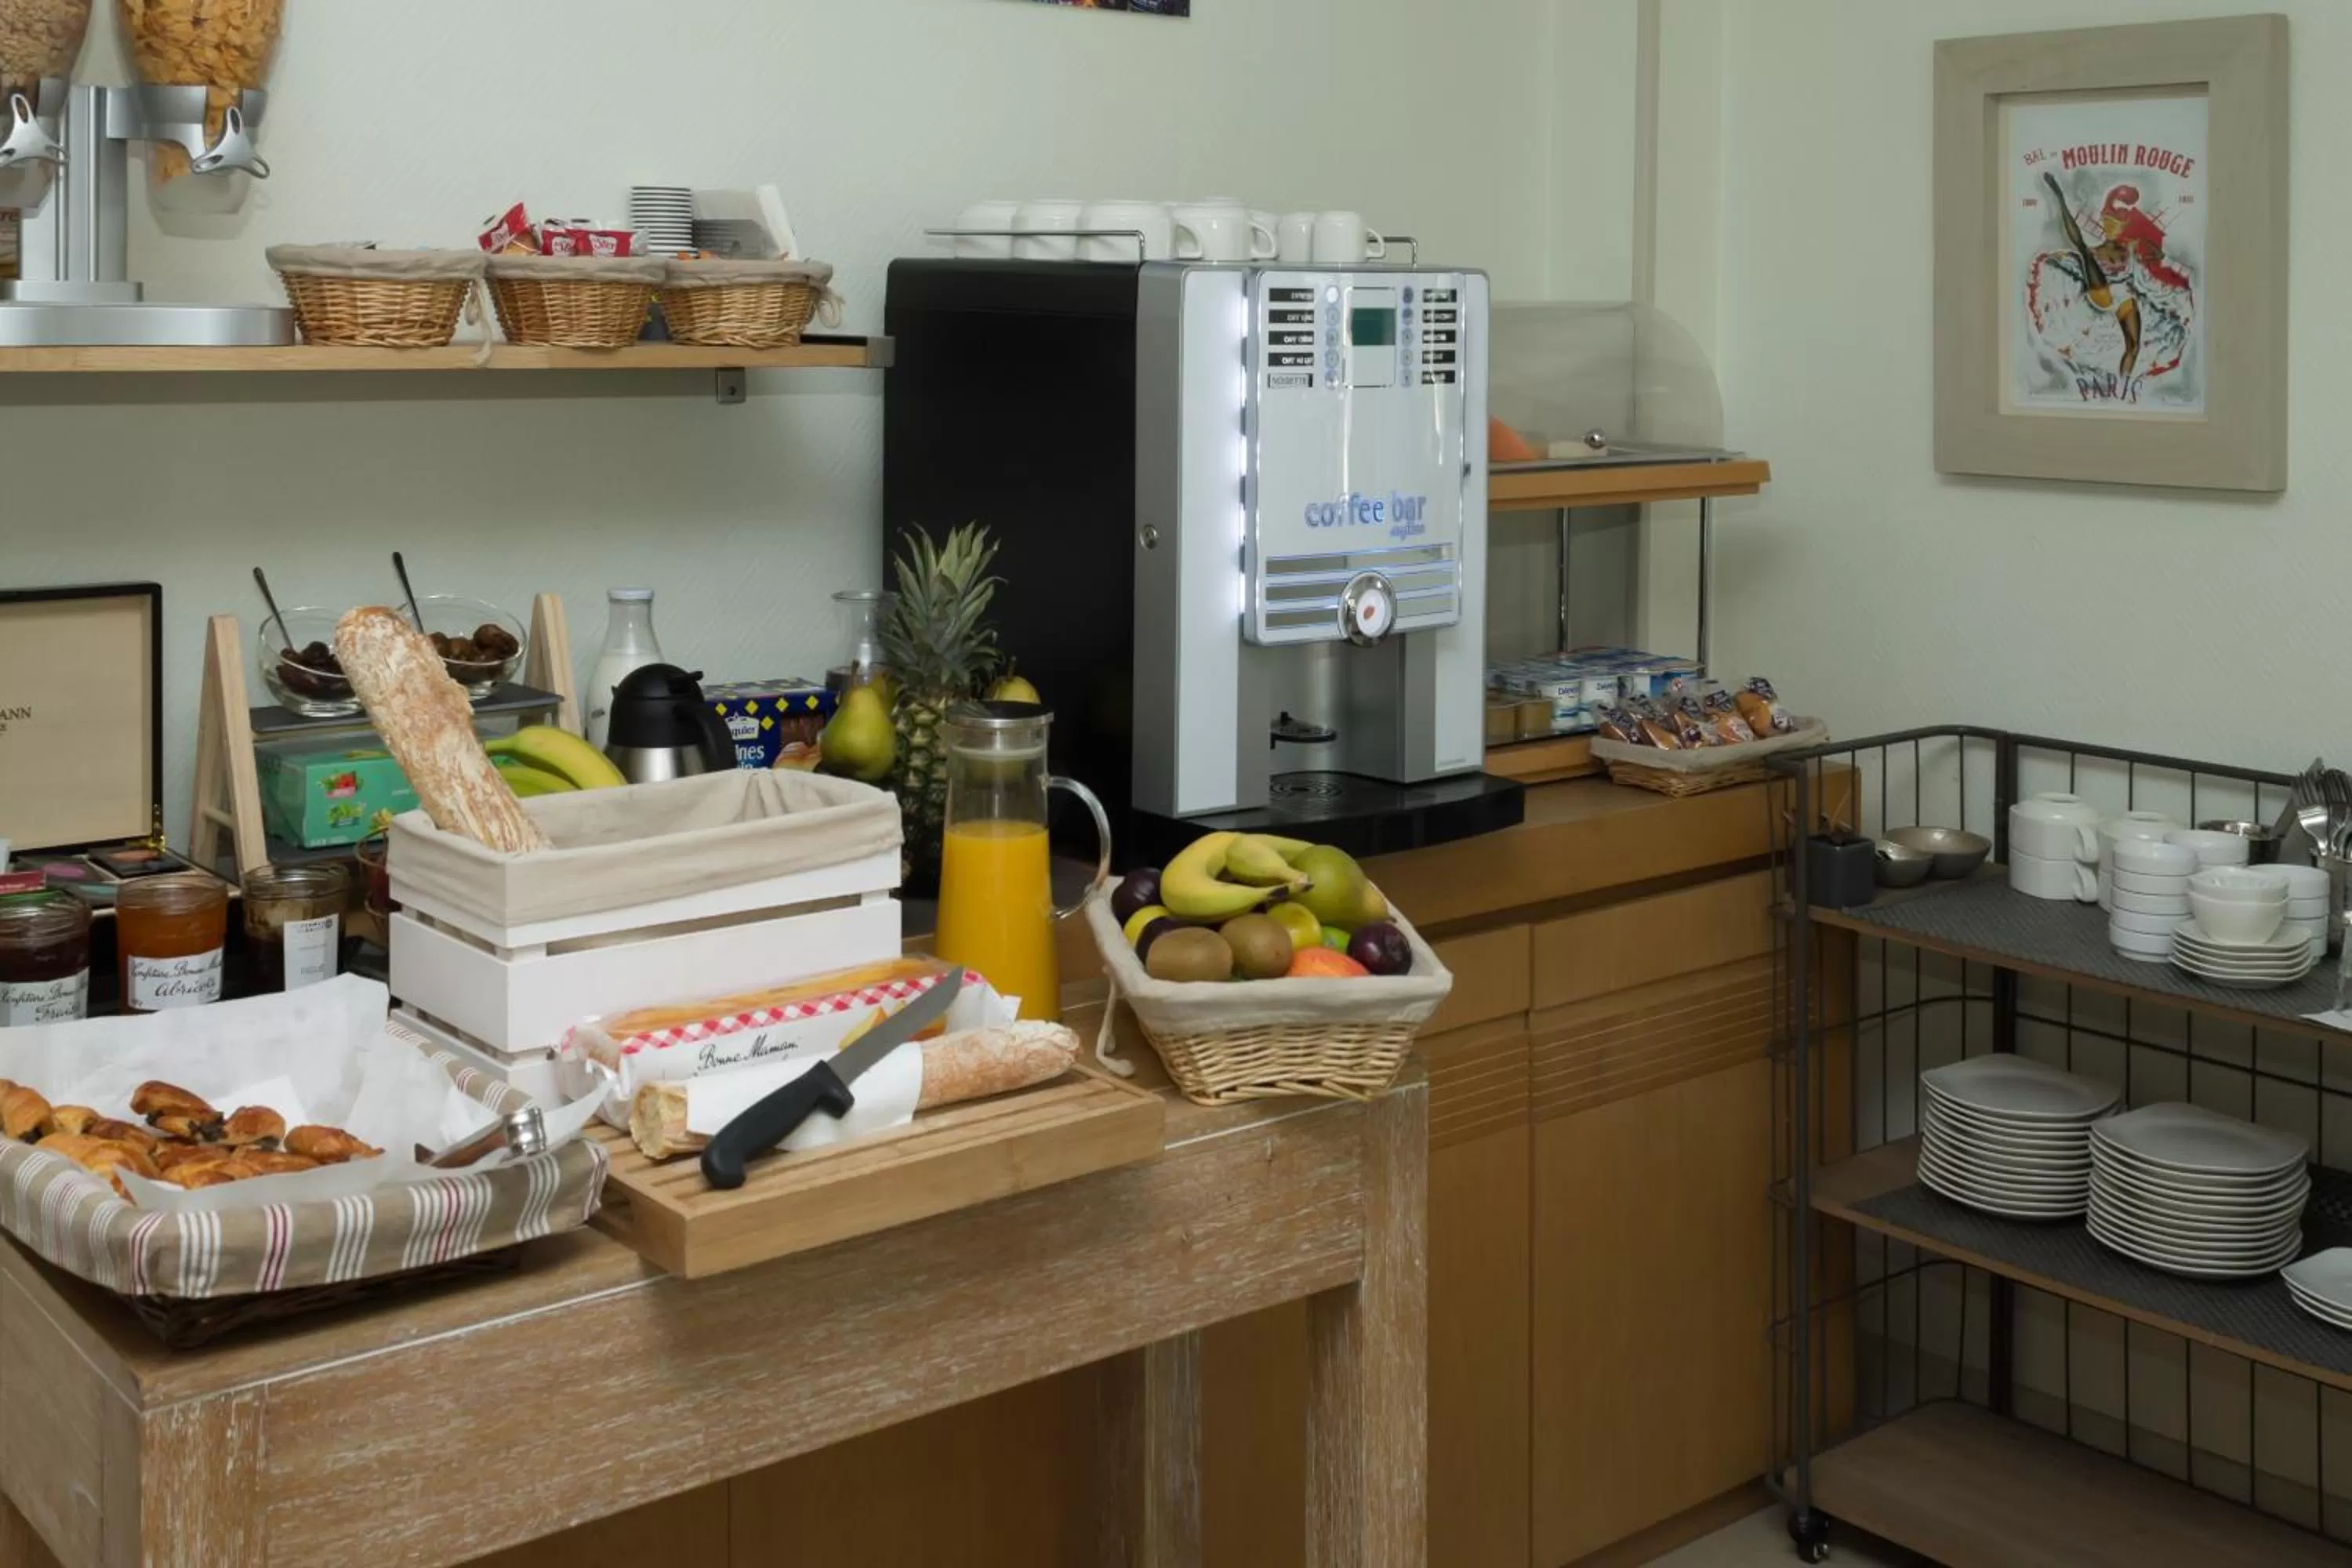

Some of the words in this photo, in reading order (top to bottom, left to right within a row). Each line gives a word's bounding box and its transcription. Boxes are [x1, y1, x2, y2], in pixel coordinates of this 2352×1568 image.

[2062, 143, 2129, 170] MOULIN
[2134, 144, 2194, 178] ROUGE
[2077, 374, 2143, 402] PARIS
[1305, 492, 1384, 529] coffee
[1391, 489, 1427, 523] bar
[731, 725, 755, 736] quier
[693, 1044, 741, 1070] Bonne
[746, 1033, 798, 1058] Maman
